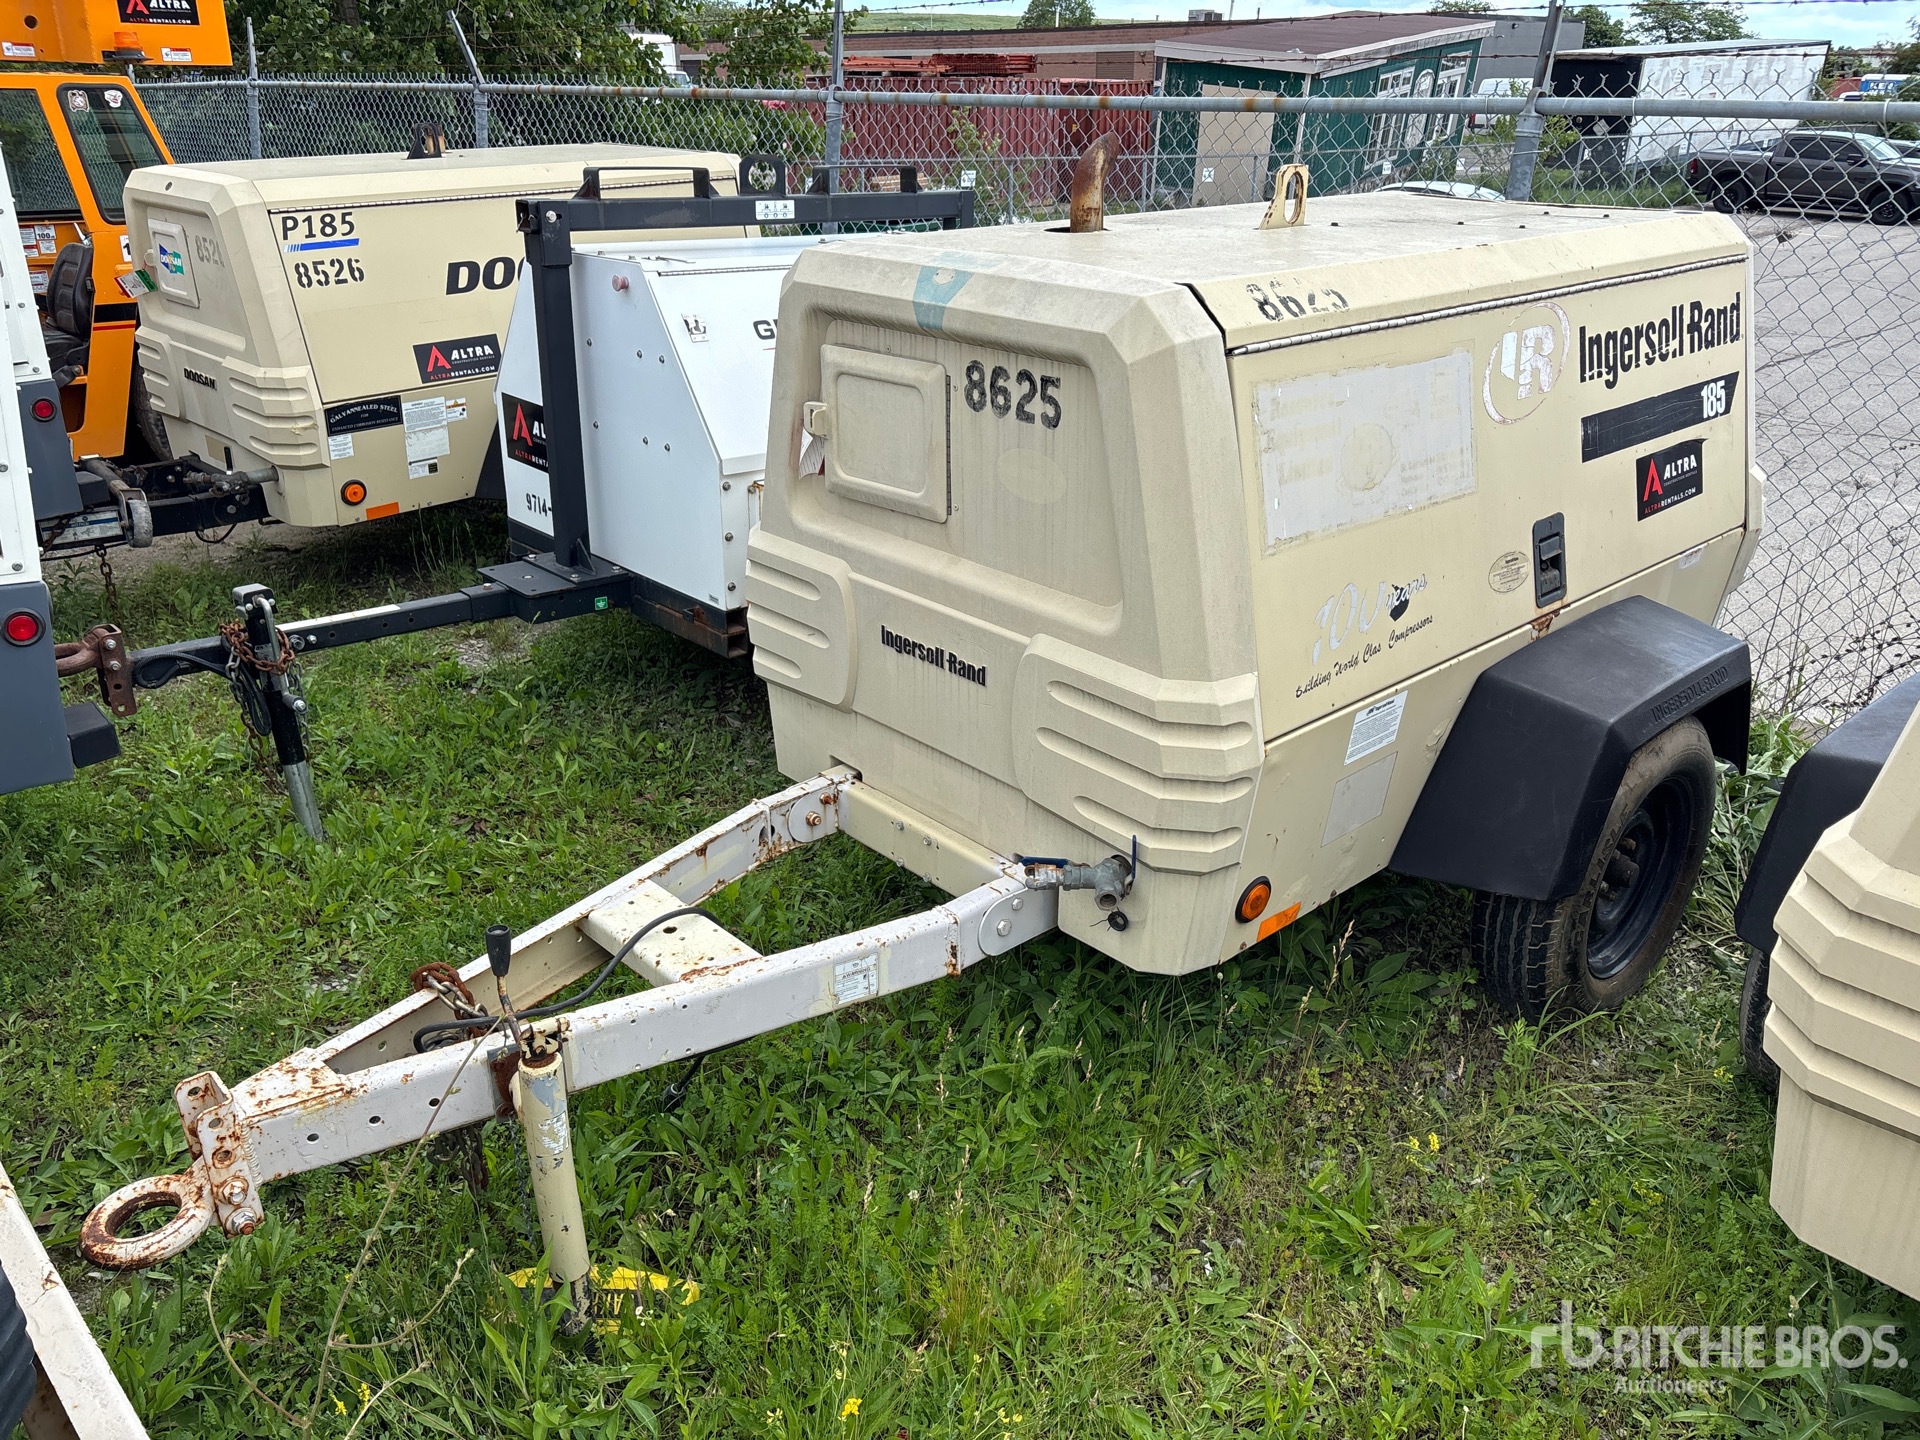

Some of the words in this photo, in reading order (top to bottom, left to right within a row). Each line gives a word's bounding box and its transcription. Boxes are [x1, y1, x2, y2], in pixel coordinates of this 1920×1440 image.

[149, 0, 191, 10] ALTRA
[129, 17, 192, 25] ALTRARENTALS.COM
[281, 211, 355, 241] P185
[293, 257, 365, 289] 8526
[446, 256, 525, 295] DO
[753, 319, 778, 340] G
[451, 345, 494, 360] ALTRA
[183, 367, 217, 391] DOOSAN
[430, 365, 495, 380] ALTRARENTALS.COM
[964, 360, 1062, 430] 8625
[1701, 380, 1726, 419] 185
[330, 404, 379, 423] GALVANNEALED
[379, 404, 398, 413] STEEL
[1663, 454, 1698, 480] ALTRA
[1644, 486, 1697, 514] ALTRARENTALS.COM
[1388, 615, 1434, 649] Compressors
